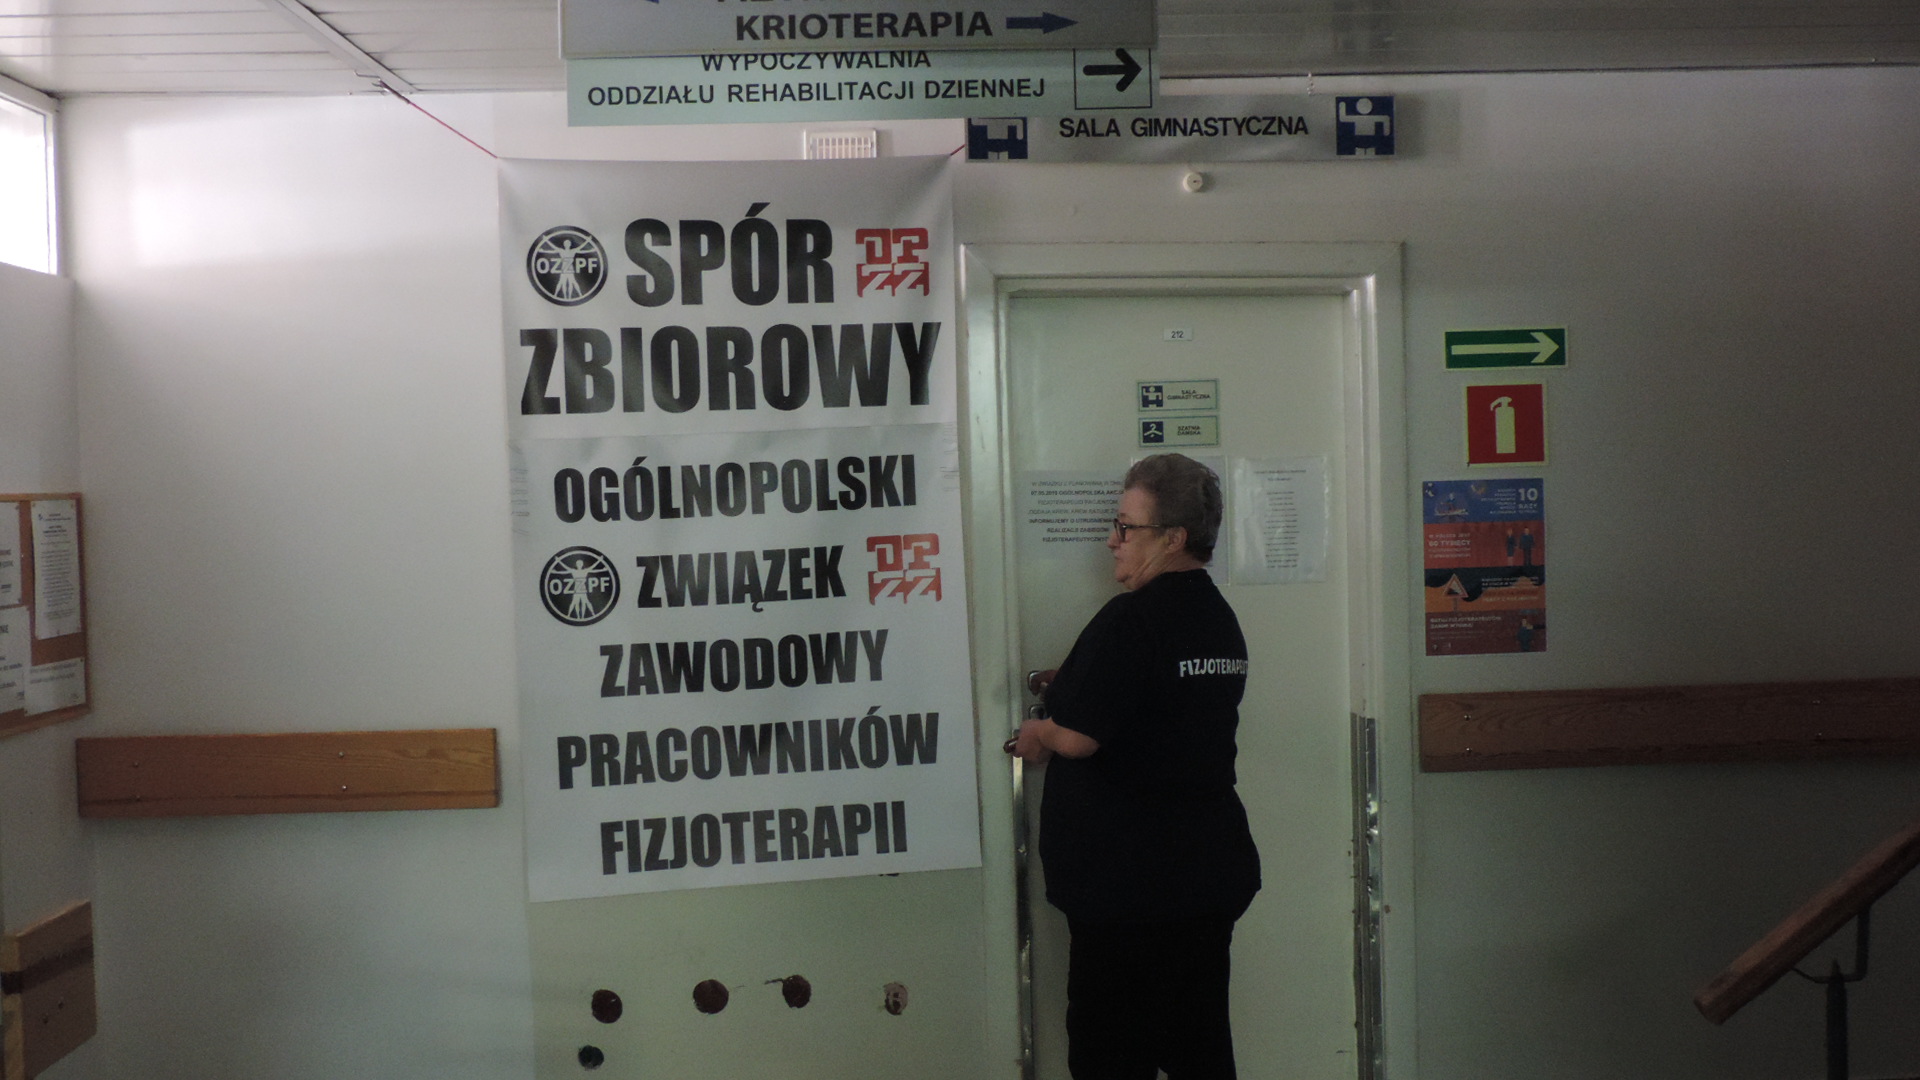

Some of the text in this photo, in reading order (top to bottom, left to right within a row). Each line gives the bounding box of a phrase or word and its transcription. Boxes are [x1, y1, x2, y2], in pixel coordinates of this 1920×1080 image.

[736, 11, 993, 41] KRIOTERAPIA
[702, 51, 931, 71] WYPOCZYWALNIA
[588, 79, 1045, 106] ODDZIAŁU REHABILITACJI DZIENNEJ
[1059, 116, 1309, 138] SALA GIMNASTYCZNA
[537, 257, 598, 274] OZZPF
[624, 202, 835, 307] SPÓR
[1171, 330, 1184, 339] 212
[520, 321, 942, 415] ZBIOROWY
[554, 454, 917, 523] OGÓLNOPOLSKI
[1518, 488, 1539, 501] 10
[549, 577, 610, 595] OZZPF
[636, 545, 847, 613] ZWIĄZEK
[600, 628, 889, 698] ZAWODOWY
[557, 705, 940, 790] PRACOWNIKÓW
[600, 800, 908, 876] FIZJOTERAPII
